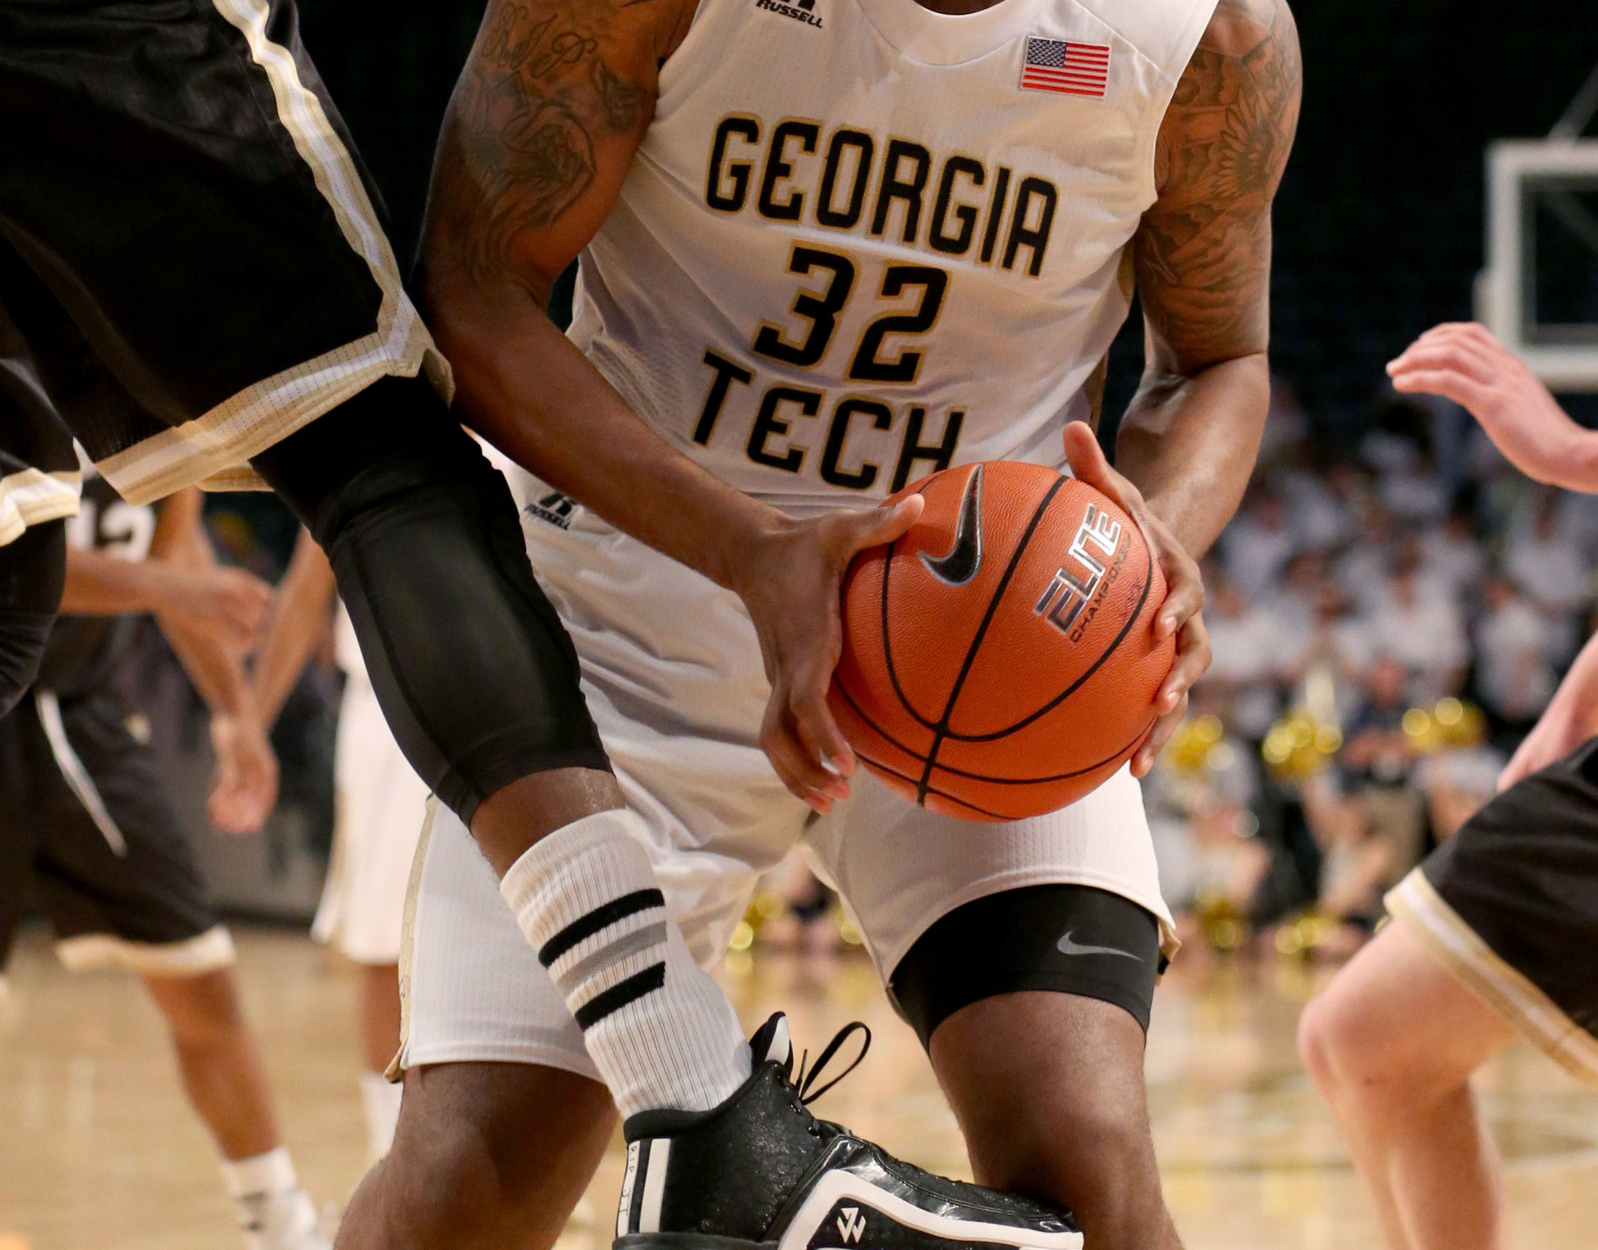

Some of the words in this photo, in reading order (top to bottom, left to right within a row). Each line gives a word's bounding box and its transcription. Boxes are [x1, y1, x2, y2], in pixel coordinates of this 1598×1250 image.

[705, 112, 1059, 279] GEORGIA
[748, 240, 951, 384] 32
[690, 348, 969, 494] TECH
[524, 503, 571, 530] RUSSELL
[1033, 502, 1121, 635] ELITE
